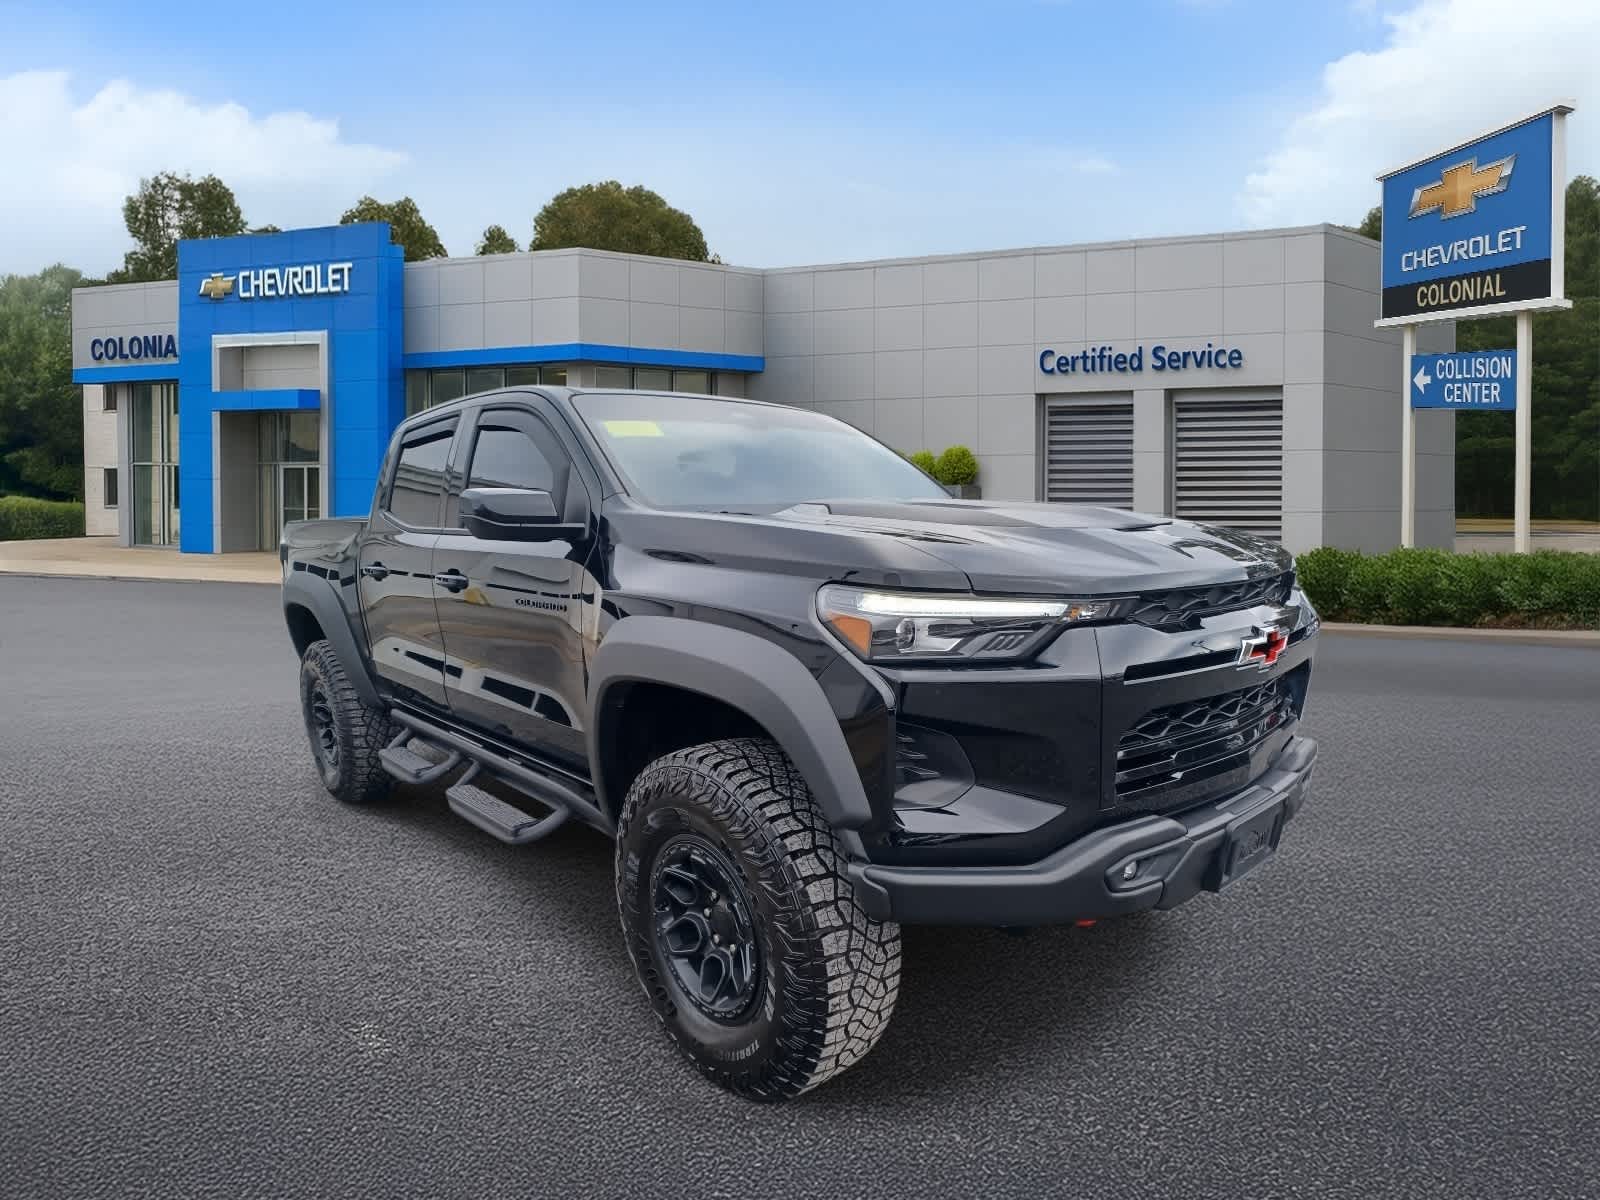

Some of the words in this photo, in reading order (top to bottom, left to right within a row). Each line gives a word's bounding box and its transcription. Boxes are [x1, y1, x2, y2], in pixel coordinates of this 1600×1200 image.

[1401, 226, 1526, 272] CHEVROLET
[239, 262, 353, 297] CHEVROLET
[1417, 274, 1505, 306] COLONIAL
[1039, 346, 1143, 374] Certified
[1151, 343, 1243, 370] Service
[1436, 357, 1511, 379] COLLISION
[1444, 383, 1500, 402] CENTER
